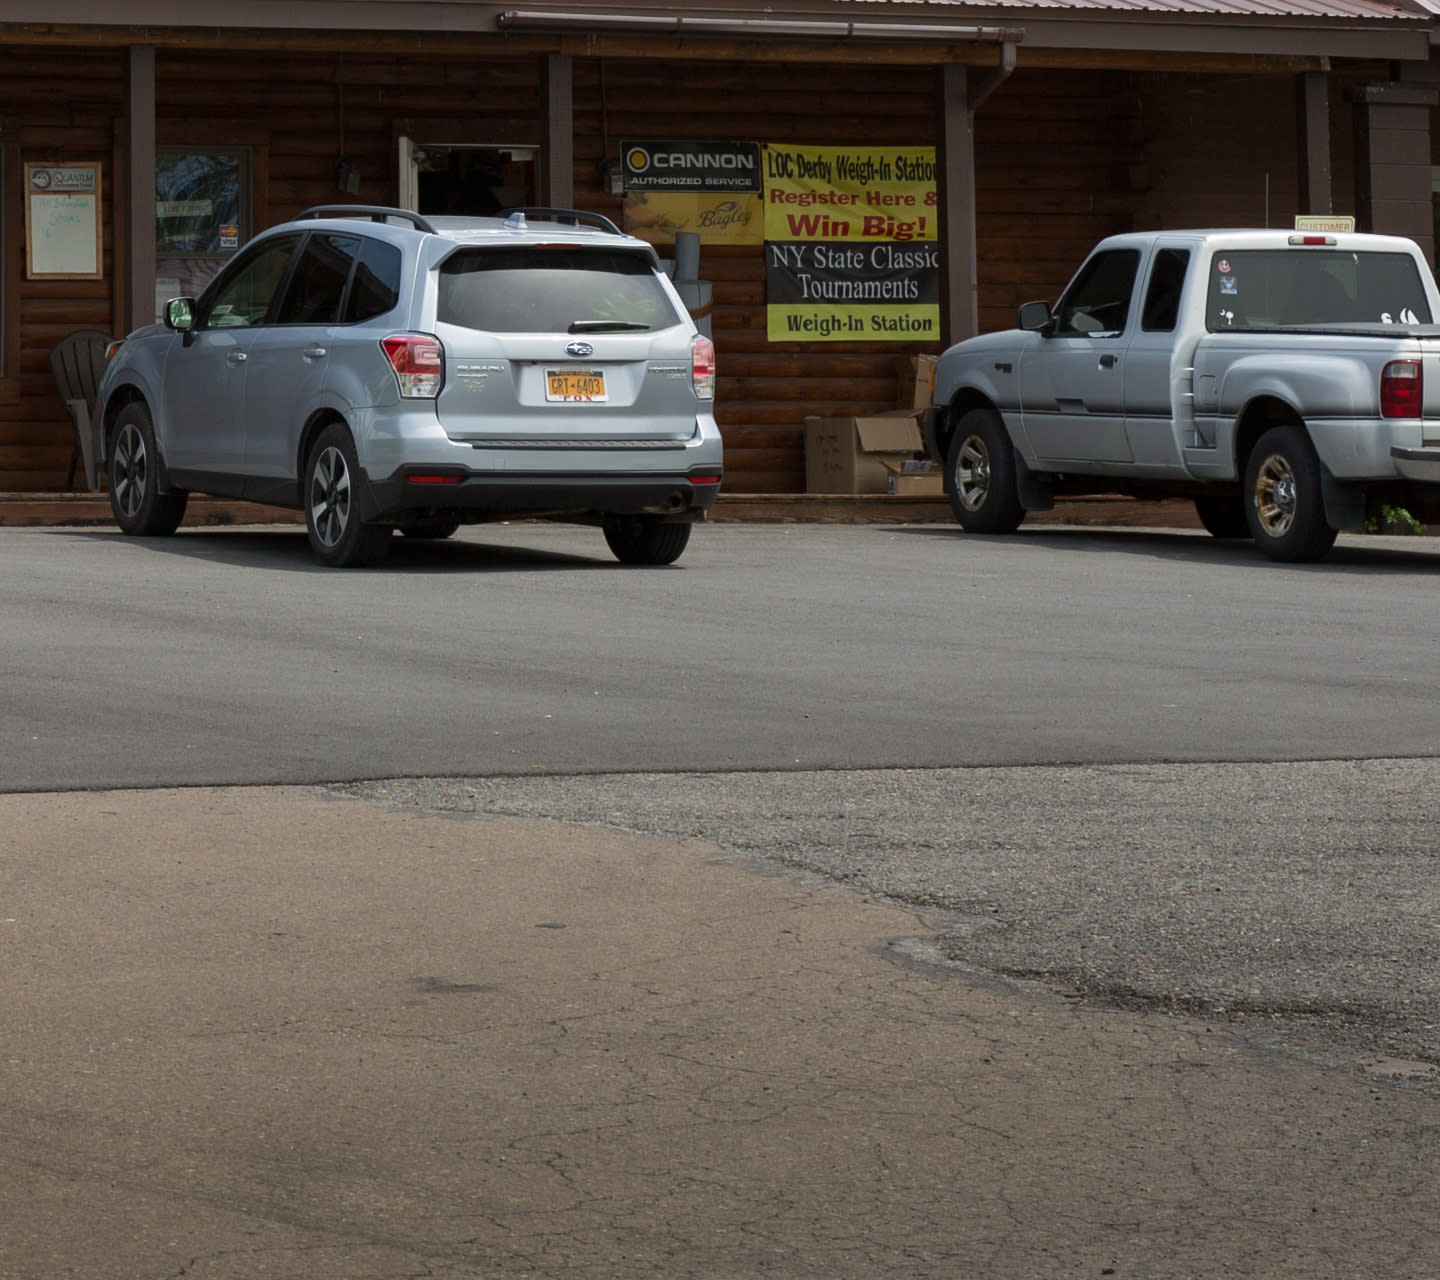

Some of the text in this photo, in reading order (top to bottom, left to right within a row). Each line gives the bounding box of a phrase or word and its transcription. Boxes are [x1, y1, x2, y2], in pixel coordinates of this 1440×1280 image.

[653, 153, 753, 168] CANNON
[768, 152, 793, 178] LOC
[796, 153, 832, 184] Derby
[836, 155, 891, 185] Weigh-In
[53, 171, 95, 184] QUANTUM
[631, 176, 752, 186] AUTHORIZED SERVICE
[770, 188, 937, 207] Register Here &
[786, 214, 926, 240] Win Big!
[772, 245, 940, 269] NY State Classic
[797, 274, 919, 299] Tournaments
[787, 313, 933, 336] Weigh-In Station
